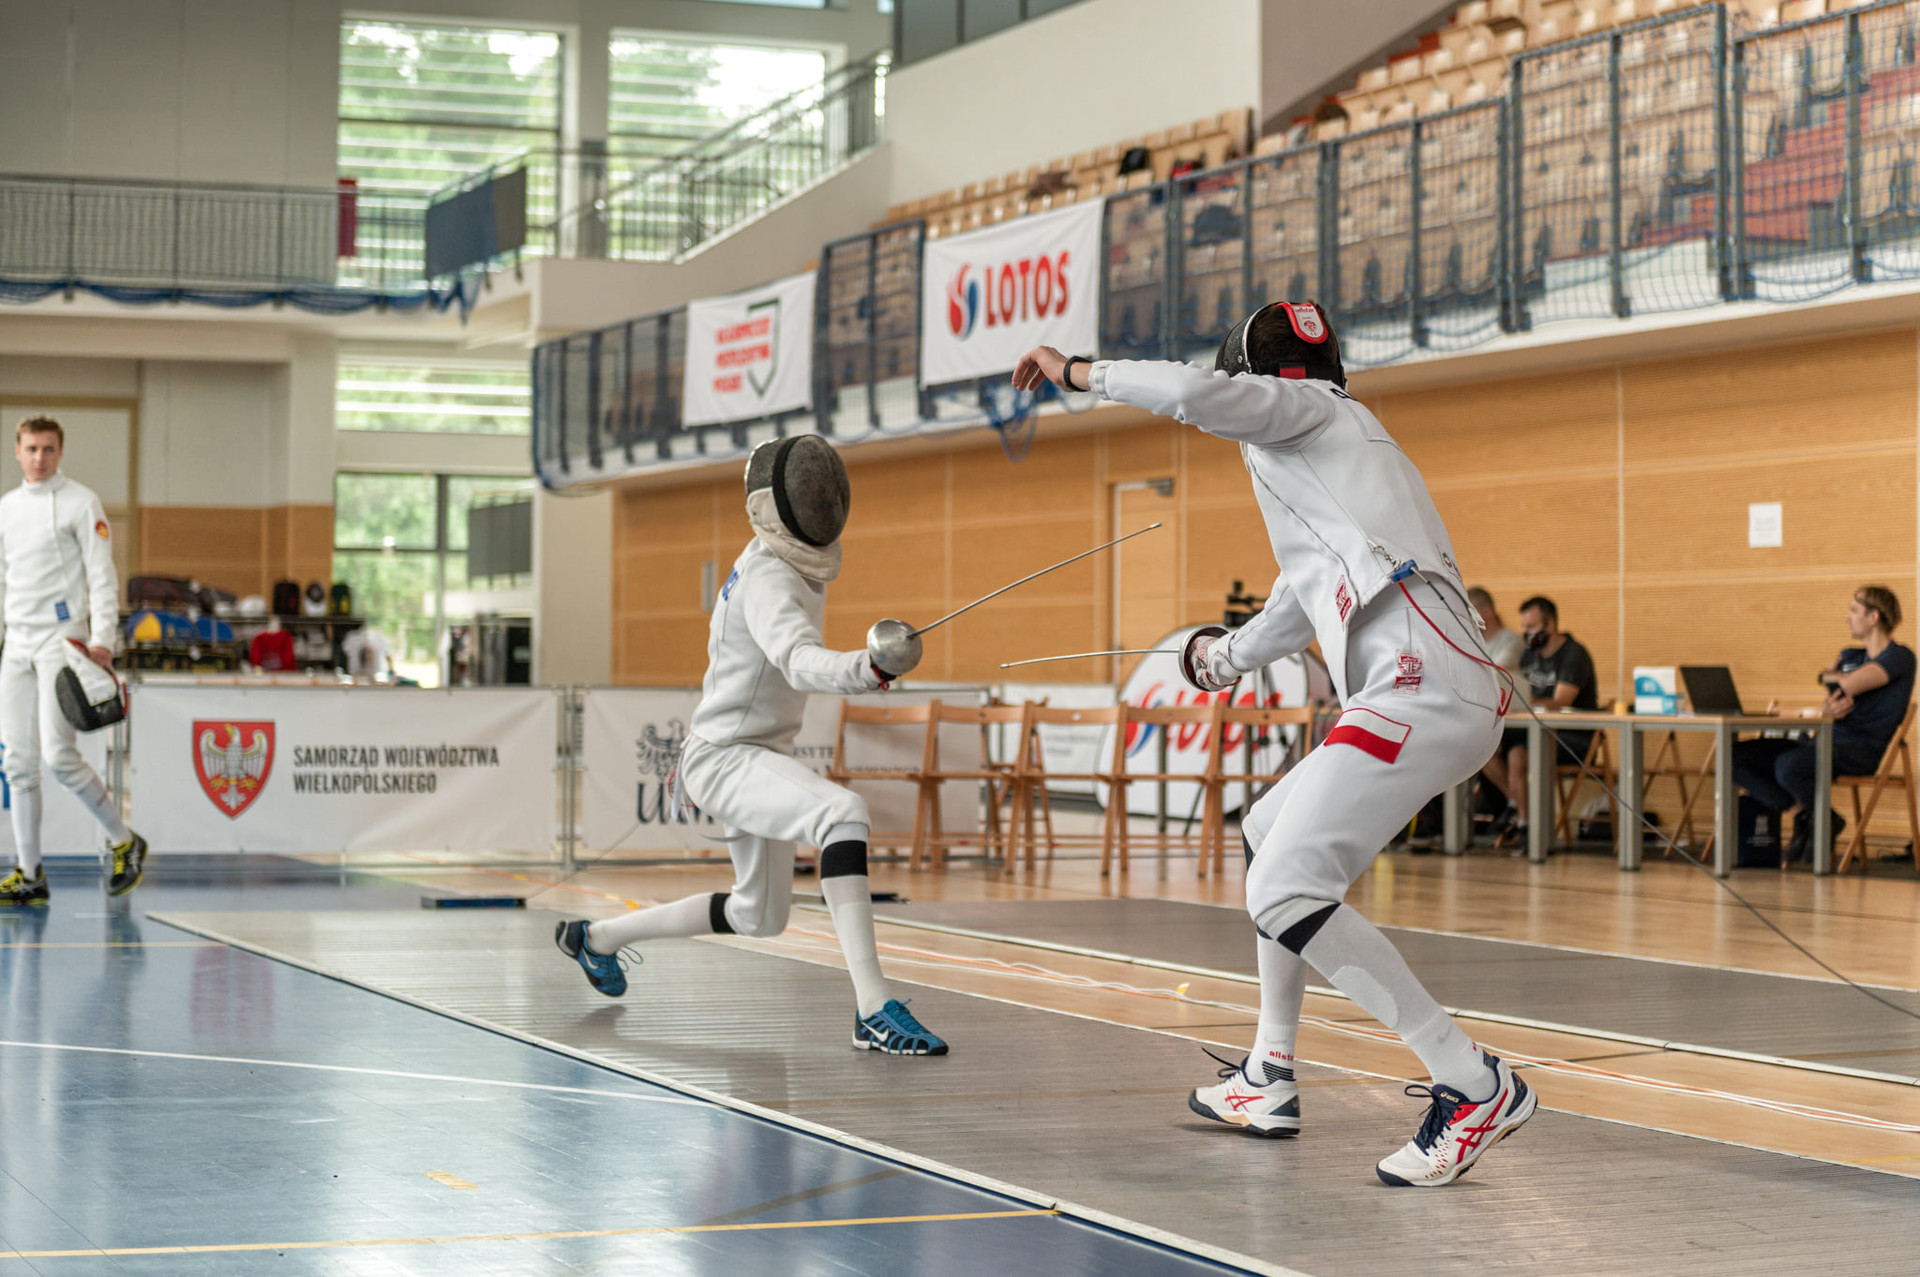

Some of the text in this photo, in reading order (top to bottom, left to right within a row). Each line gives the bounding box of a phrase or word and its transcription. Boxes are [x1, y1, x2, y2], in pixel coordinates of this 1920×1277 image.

[985, 248, 1069, 328] LOTOS
[294, 741, 500, 772] SAMORZĄD WOJEWÓDZTWA
[293, 771, 438, 795] WIELKOPOLSKIEGO
